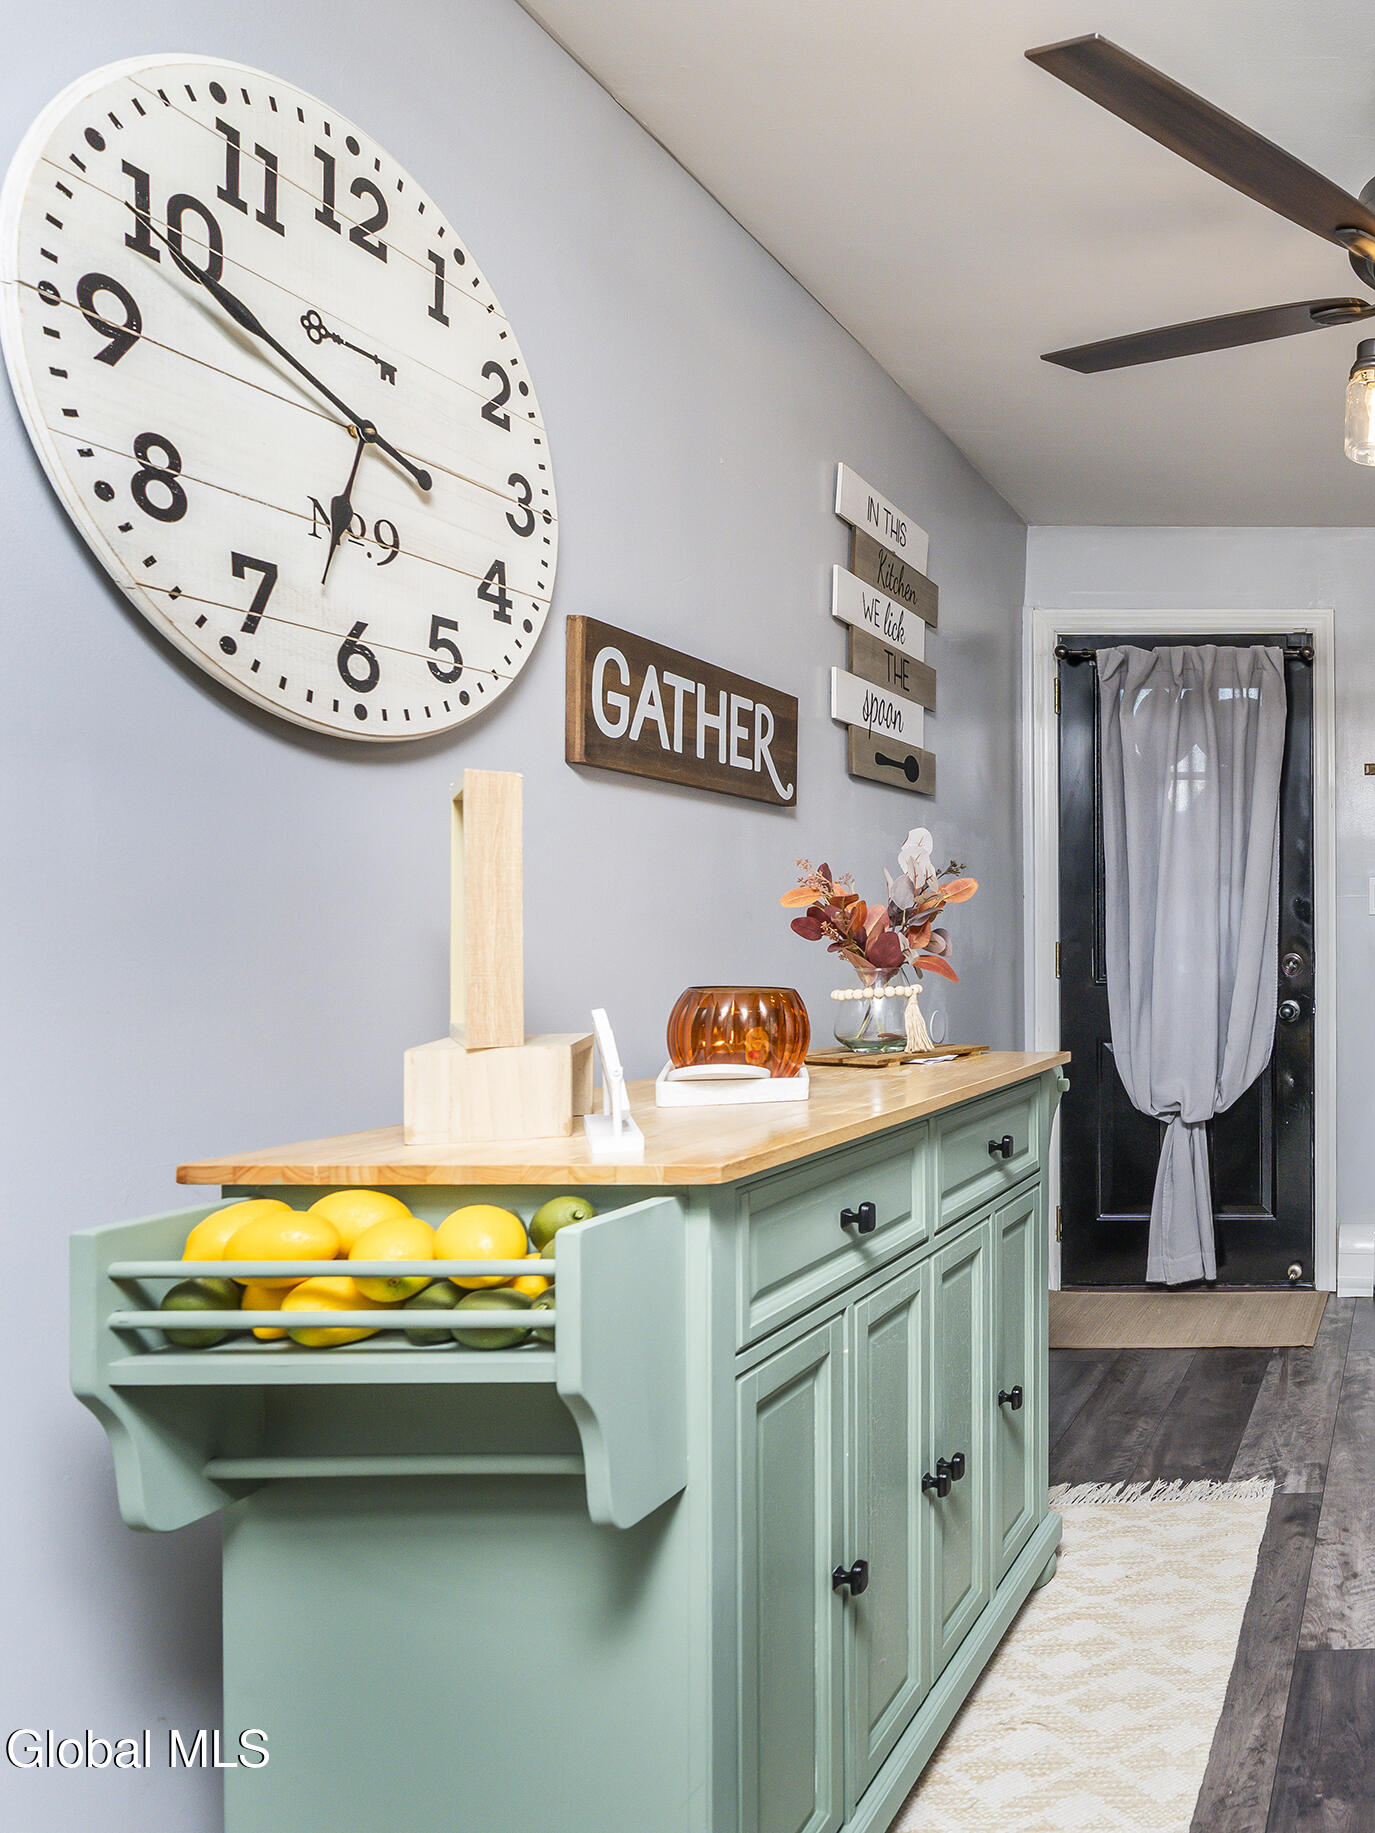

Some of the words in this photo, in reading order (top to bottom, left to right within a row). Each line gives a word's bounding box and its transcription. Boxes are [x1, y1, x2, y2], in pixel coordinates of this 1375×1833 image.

[215, 116, 286, 237] 11
[313, 144, 389, 263] 12
[122, 159, 224, 286] 10
[76, 272, 143, 367] 9
[426, 248, 450, 327] 1
[480, 360, 512, 432] 2
[130, 431, 188, 523] 8
[505, 472, 536, 539] 3
[866, 495, 880, 528] IN
[883, 507, 908, 549] THIS
[230, 550, 279, 635] 7
[476, 559, 513, 625] 4
[876, 548, 919, 607] Kitchen
[426, 614, 464, 685] 5
[862, 591, 881, 630] WE
[883, 602, 907, 645] lick
[337, 620, 380, 693] 6
[883, 647, 911, 693] THE
[591, 645, 794, 801] GATHER
[862, 688, 905, 740] spoon
